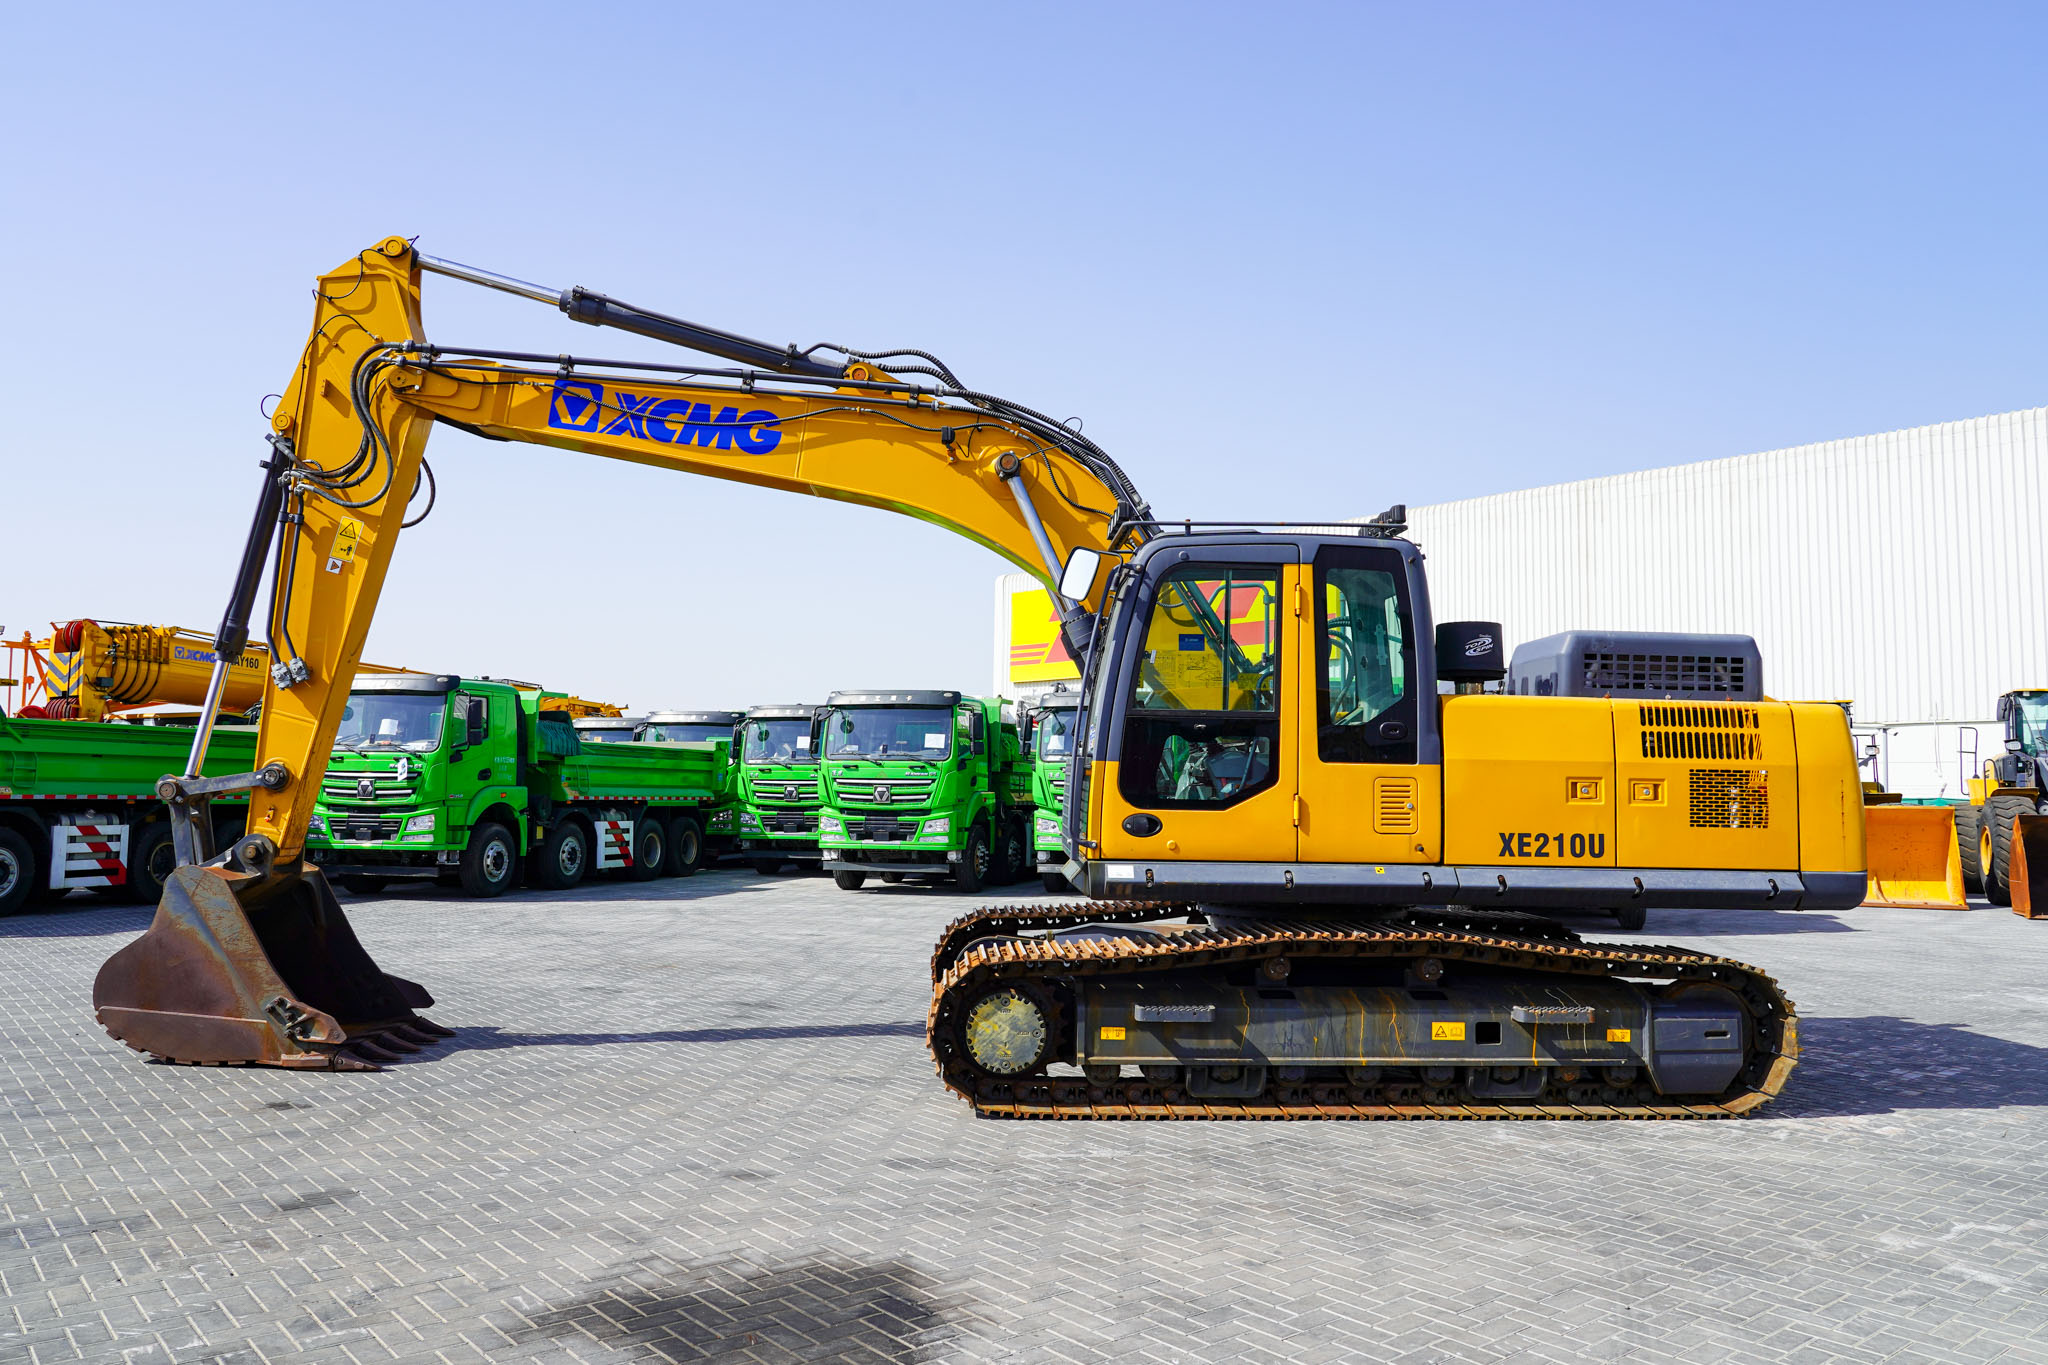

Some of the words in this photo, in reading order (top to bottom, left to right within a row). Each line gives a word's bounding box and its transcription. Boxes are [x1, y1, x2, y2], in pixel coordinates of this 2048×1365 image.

[598, 391, 783, 456] XCMG
[231, 655, 259, 669] AY160
[1498, 832, 1605, 858] XE210U
